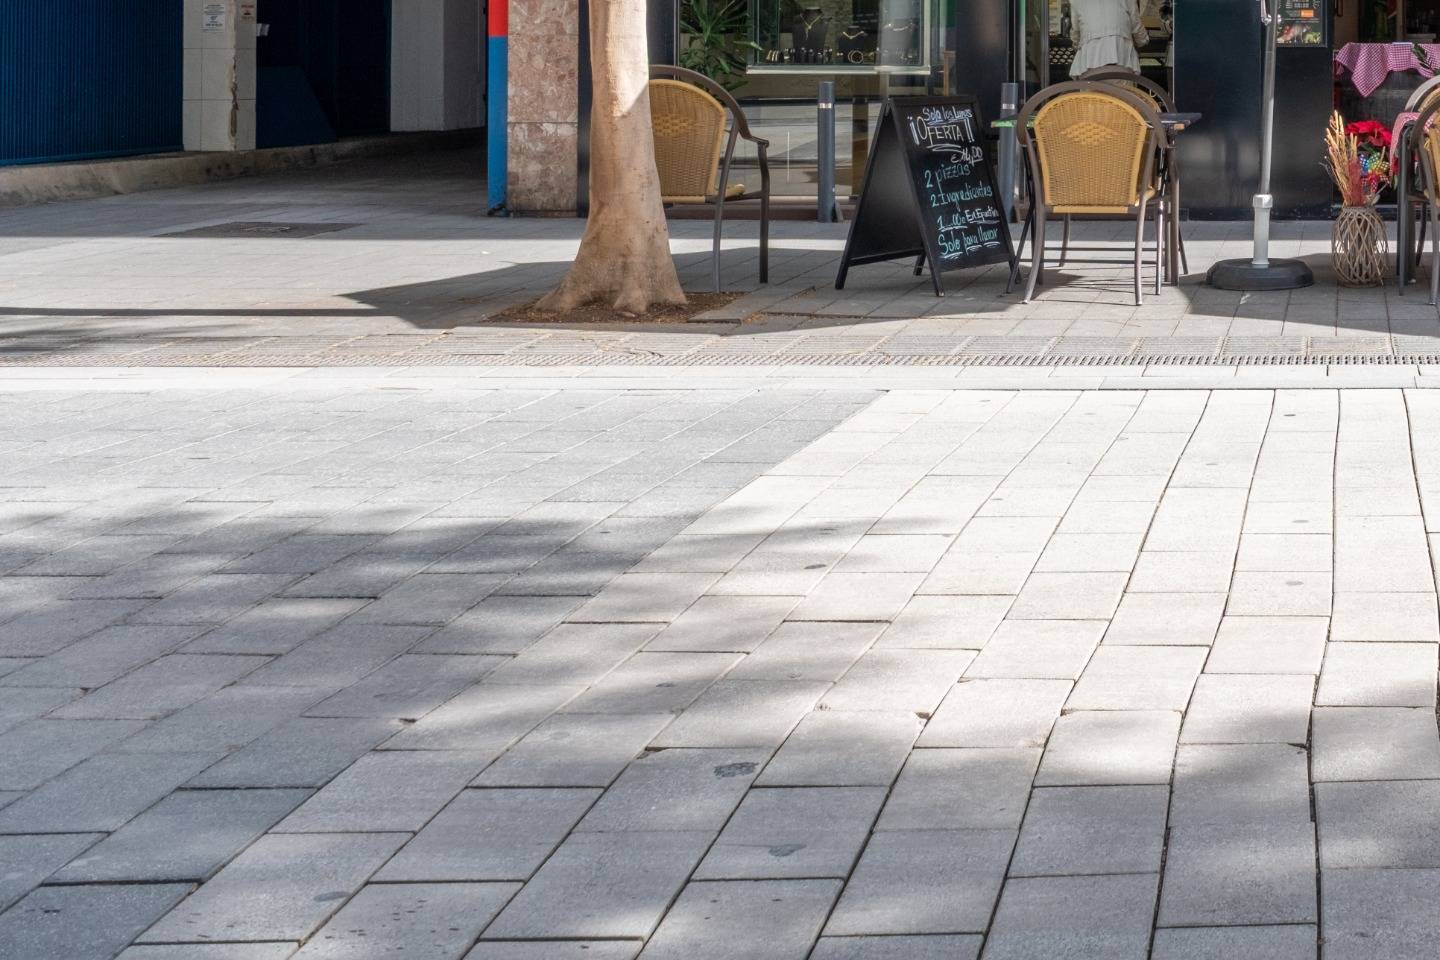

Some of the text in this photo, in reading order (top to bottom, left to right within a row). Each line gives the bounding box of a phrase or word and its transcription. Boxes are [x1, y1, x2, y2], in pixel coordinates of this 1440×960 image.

[924, 163, 971, 194] 2 pizzas
[930, 193, 940, 208] 2
[938, 230, 961, 255] Solo
